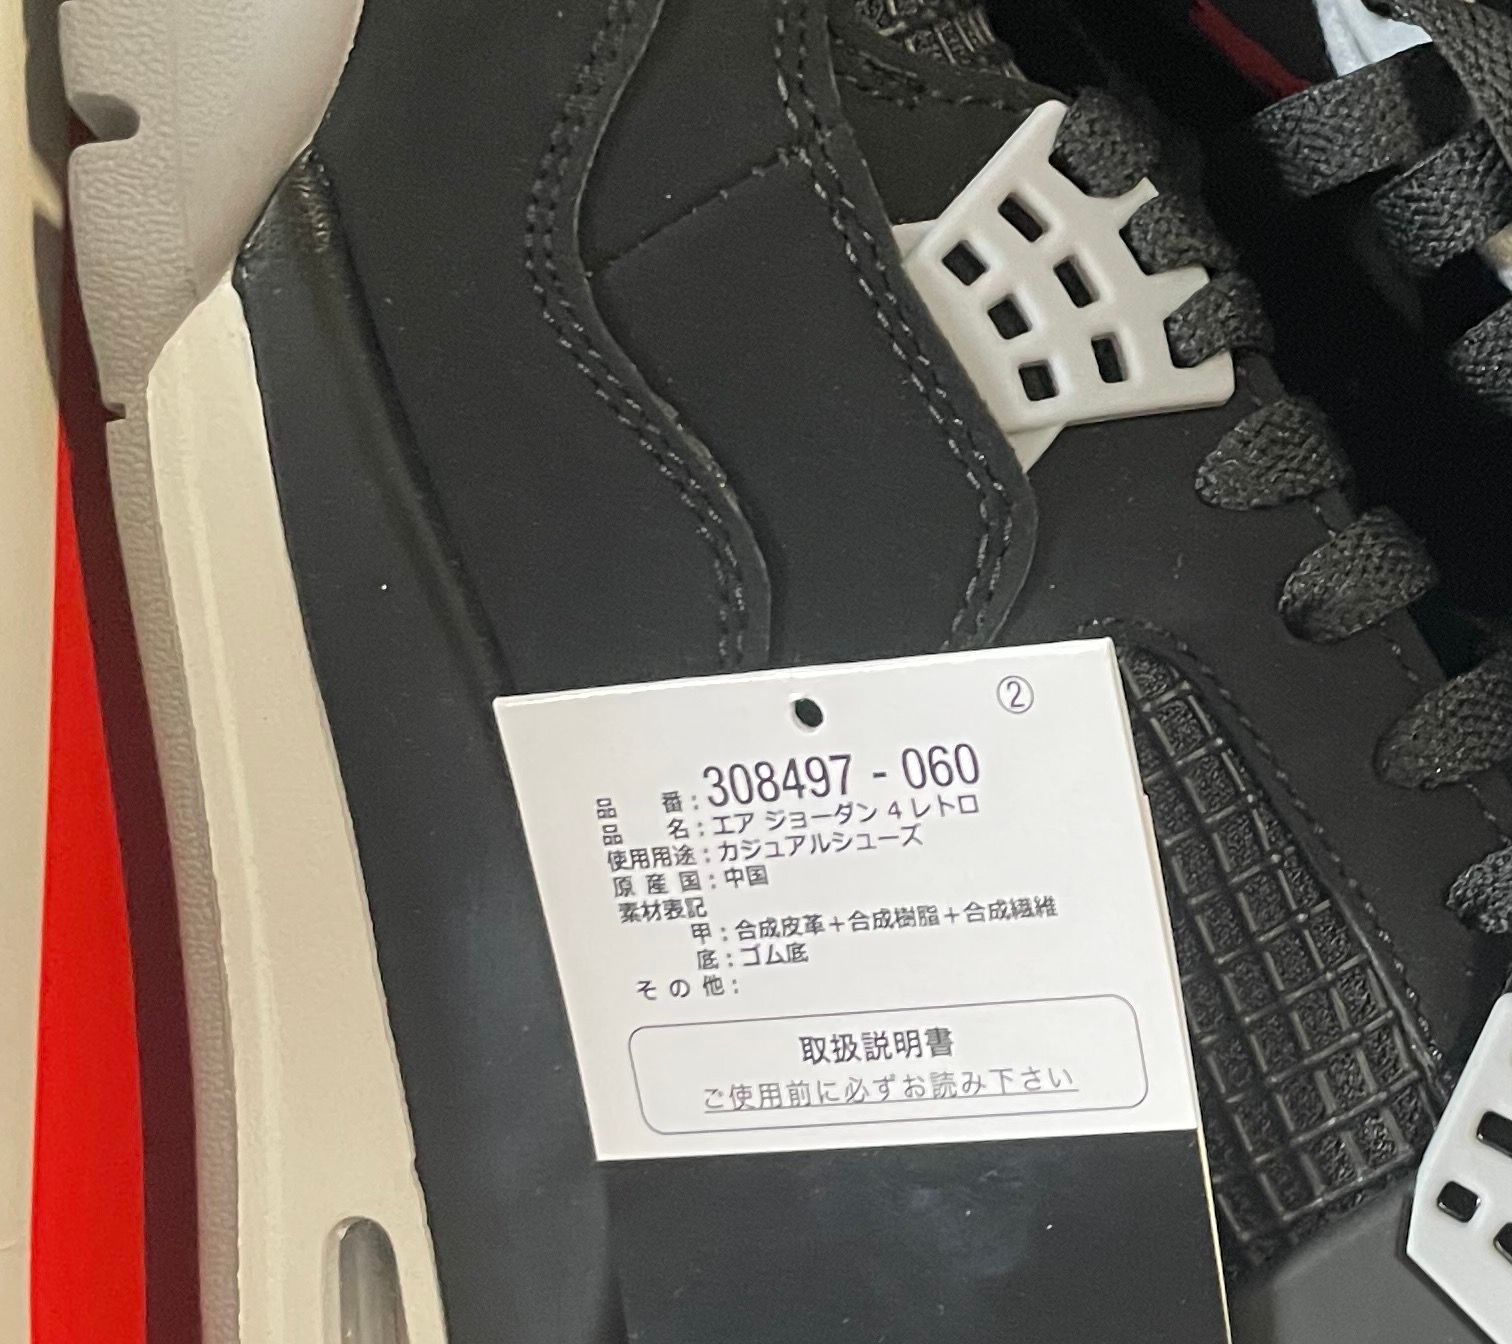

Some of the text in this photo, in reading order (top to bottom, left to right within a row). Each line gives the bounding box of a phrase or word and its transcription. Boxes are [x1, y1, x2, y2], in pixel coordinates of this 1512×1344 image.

[702, 753, 852, 807] 308497
[901, 743, 980, 789] 060
[618, 896, 708, 923] 素材表記
[798, 1027, 955, 1065] 取扱説明書
[703, 1065, 1075, 1110] ご使用前に必ずお読み下さい
